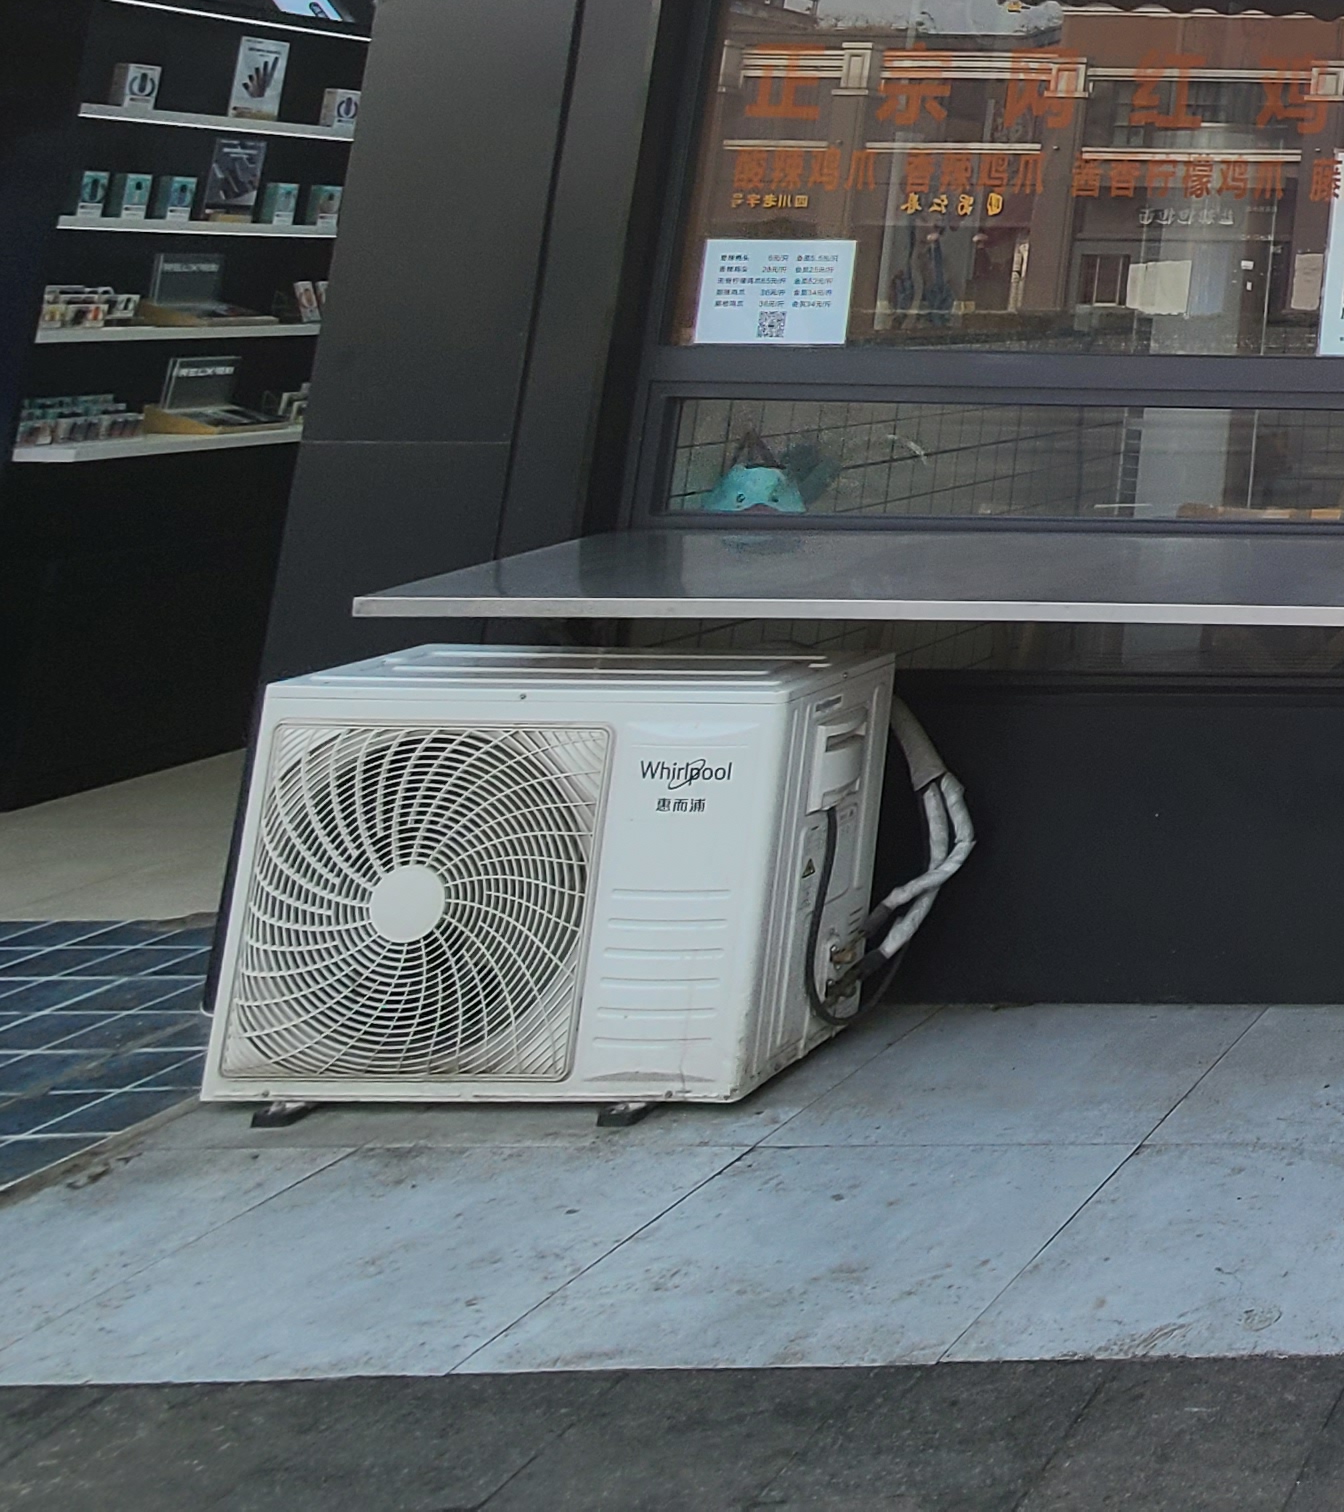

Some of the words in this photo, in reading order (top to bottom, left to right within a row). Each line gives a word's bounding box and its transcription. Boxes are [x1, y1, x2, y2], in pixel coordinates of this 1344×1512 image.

[904, 148, 1045, 195] 香辣鸡爪
[1071, 152, 1285, 200] 酱香柠檬鸡爪
[641, 758, 732, 790] Whirlpool
[656, 797, 706, 812] 惠而浦
